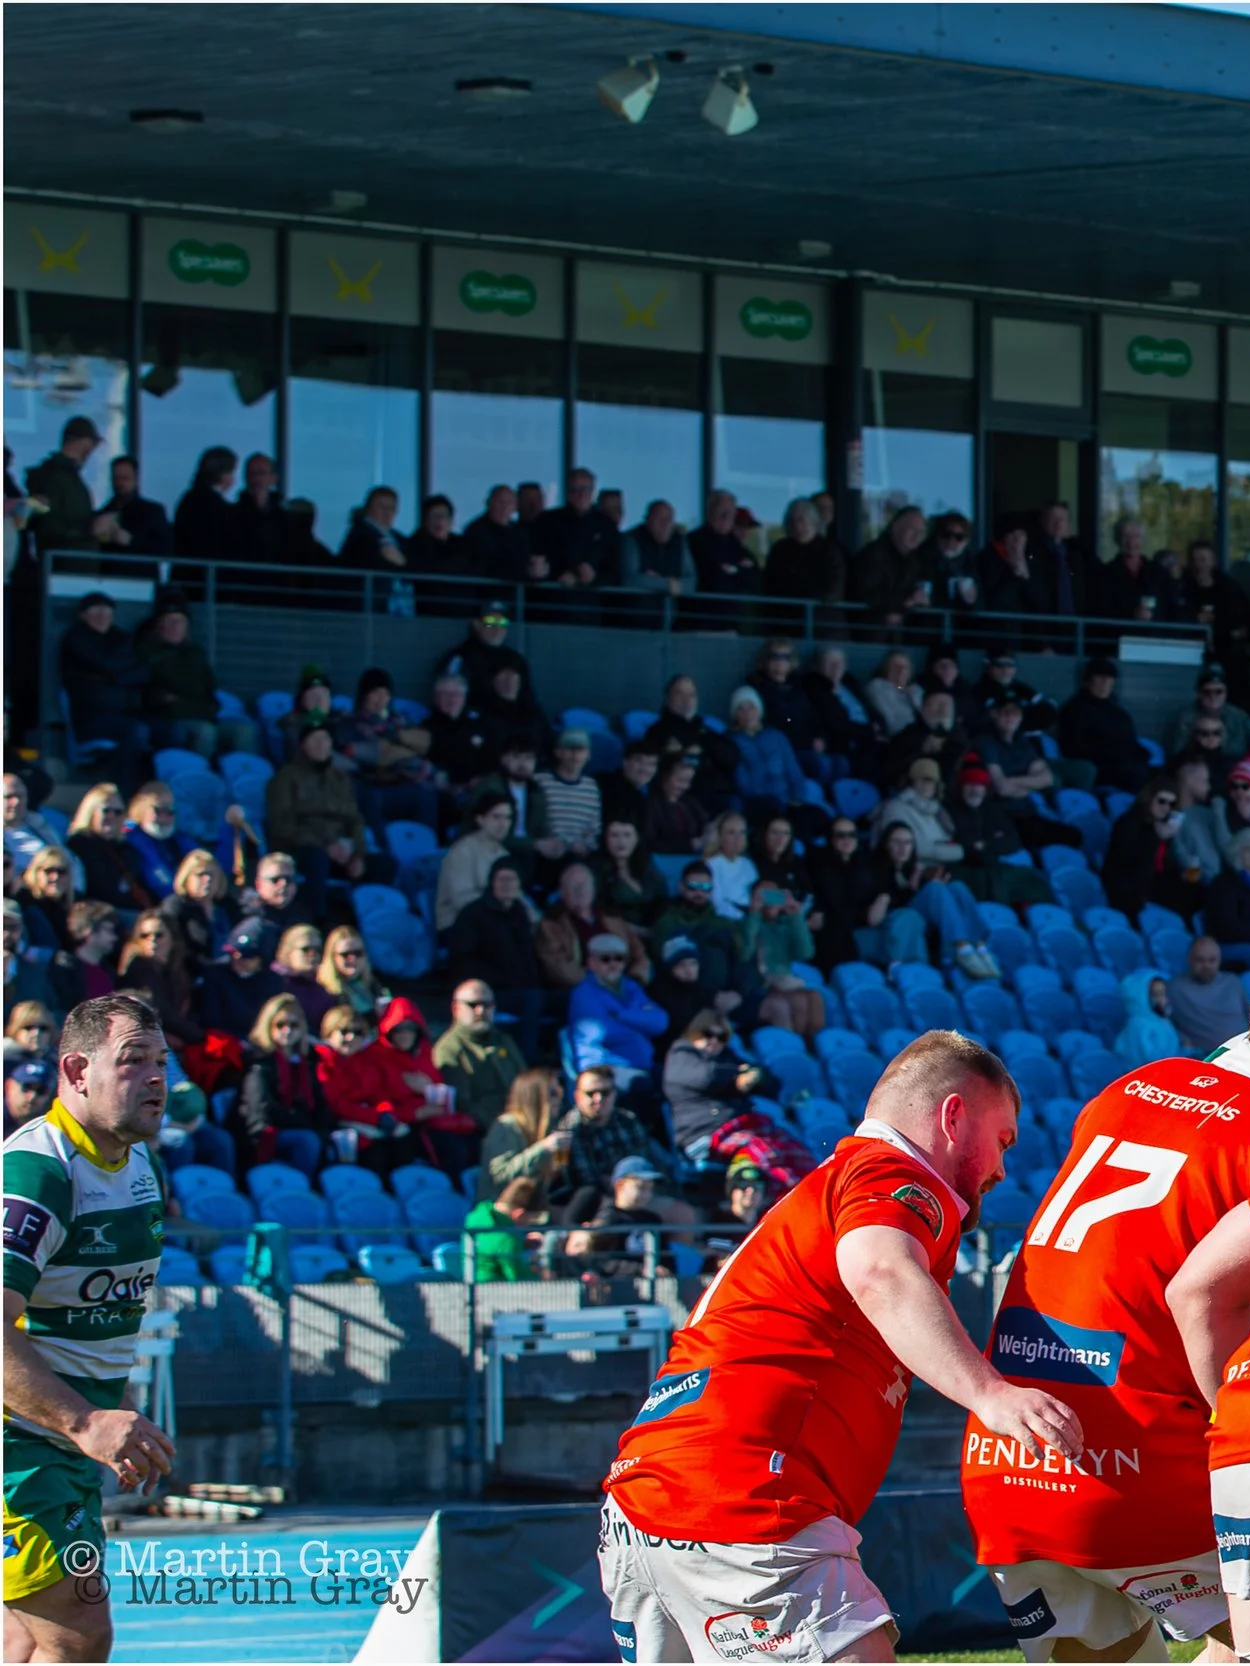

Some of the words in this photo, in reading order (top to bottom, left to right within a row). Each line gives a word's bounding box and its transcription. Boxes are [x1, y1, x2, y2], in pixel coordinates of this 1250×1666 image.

[1124, 1080, 1241, 1124] CHESTERTONS
[1027, 1134, 1188, 1253] 17
[999, 1333, 1111, 1367] Weightmans
[1003, 1475, 1077, 1493] DISTILLERY
[1174, 1583, 1220, 1604] Rugby
